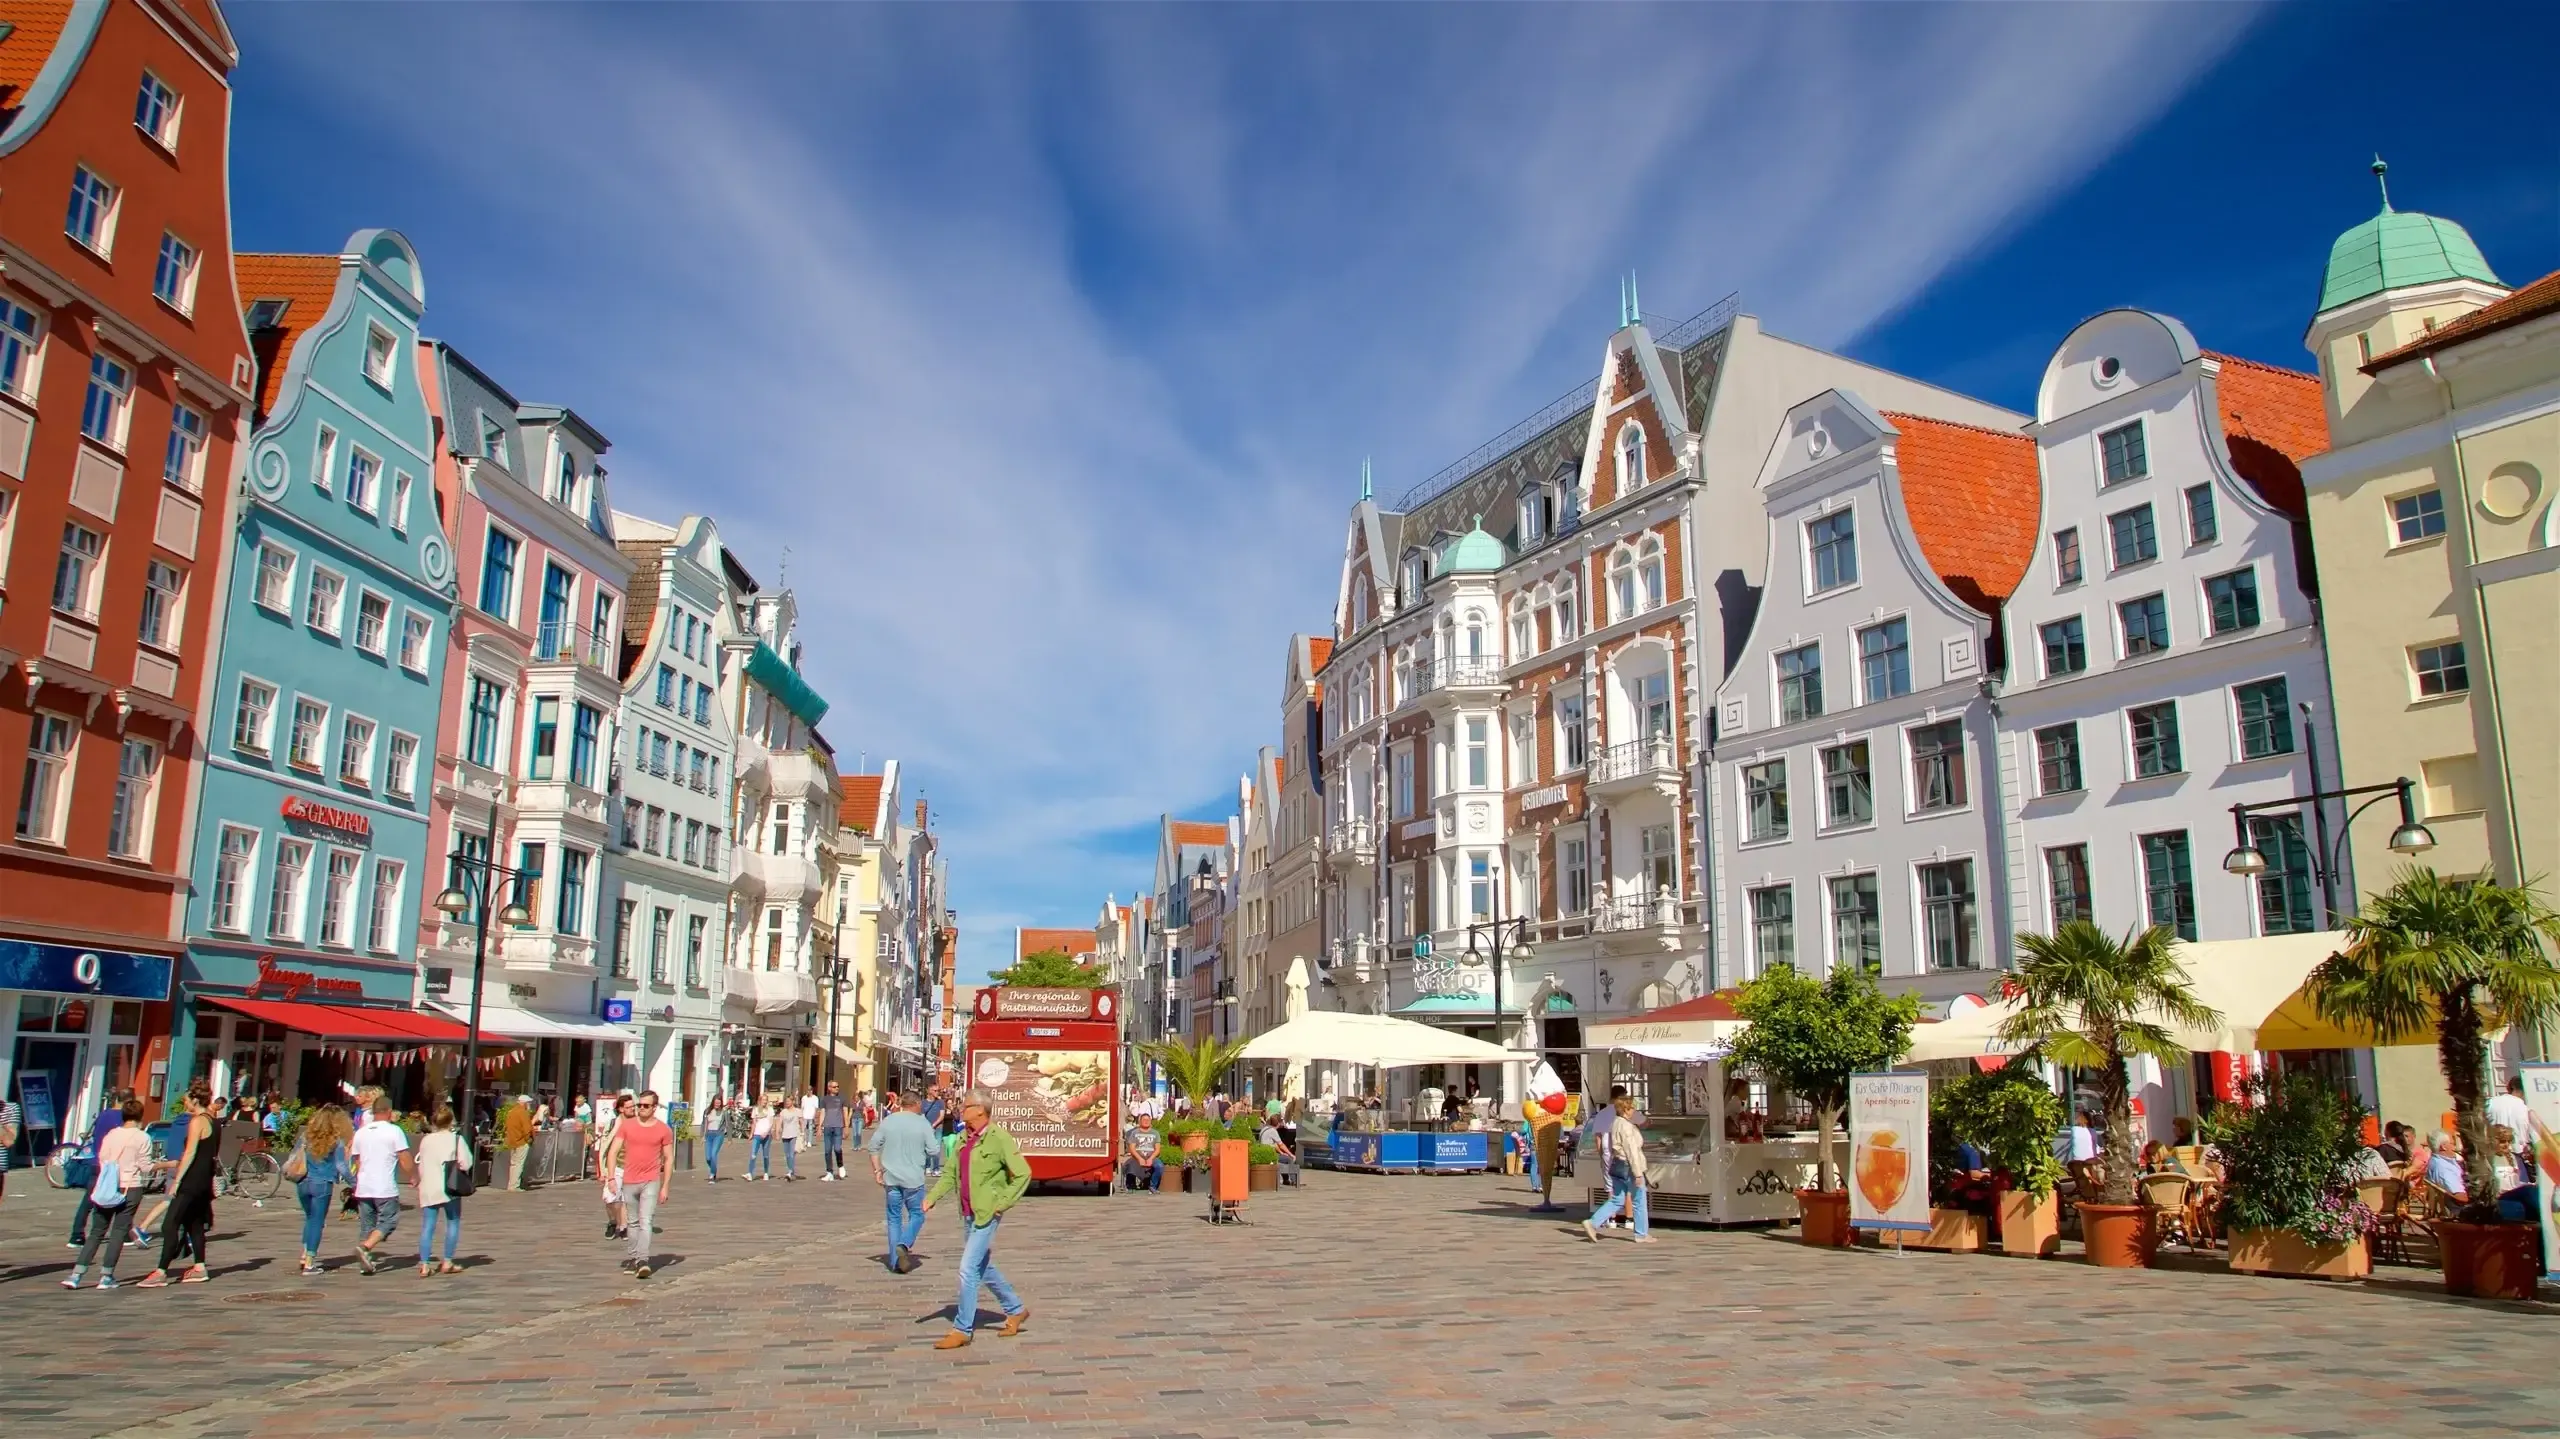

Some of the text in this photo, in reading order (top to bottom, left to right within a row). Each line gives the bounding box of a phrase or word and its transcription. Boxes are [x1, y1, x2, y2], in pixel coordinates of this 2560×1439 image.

[1009, 990, 1081, 1004] Ihre regionale
[1000, 1002, 1088, 1014] Pastamanufaktur
[1889, 1082, 1923, 1095] Milano
[2533, 1077, 2559, 1093] Eis
[1010, 1121, 1066, 1132] Kühlschrank
